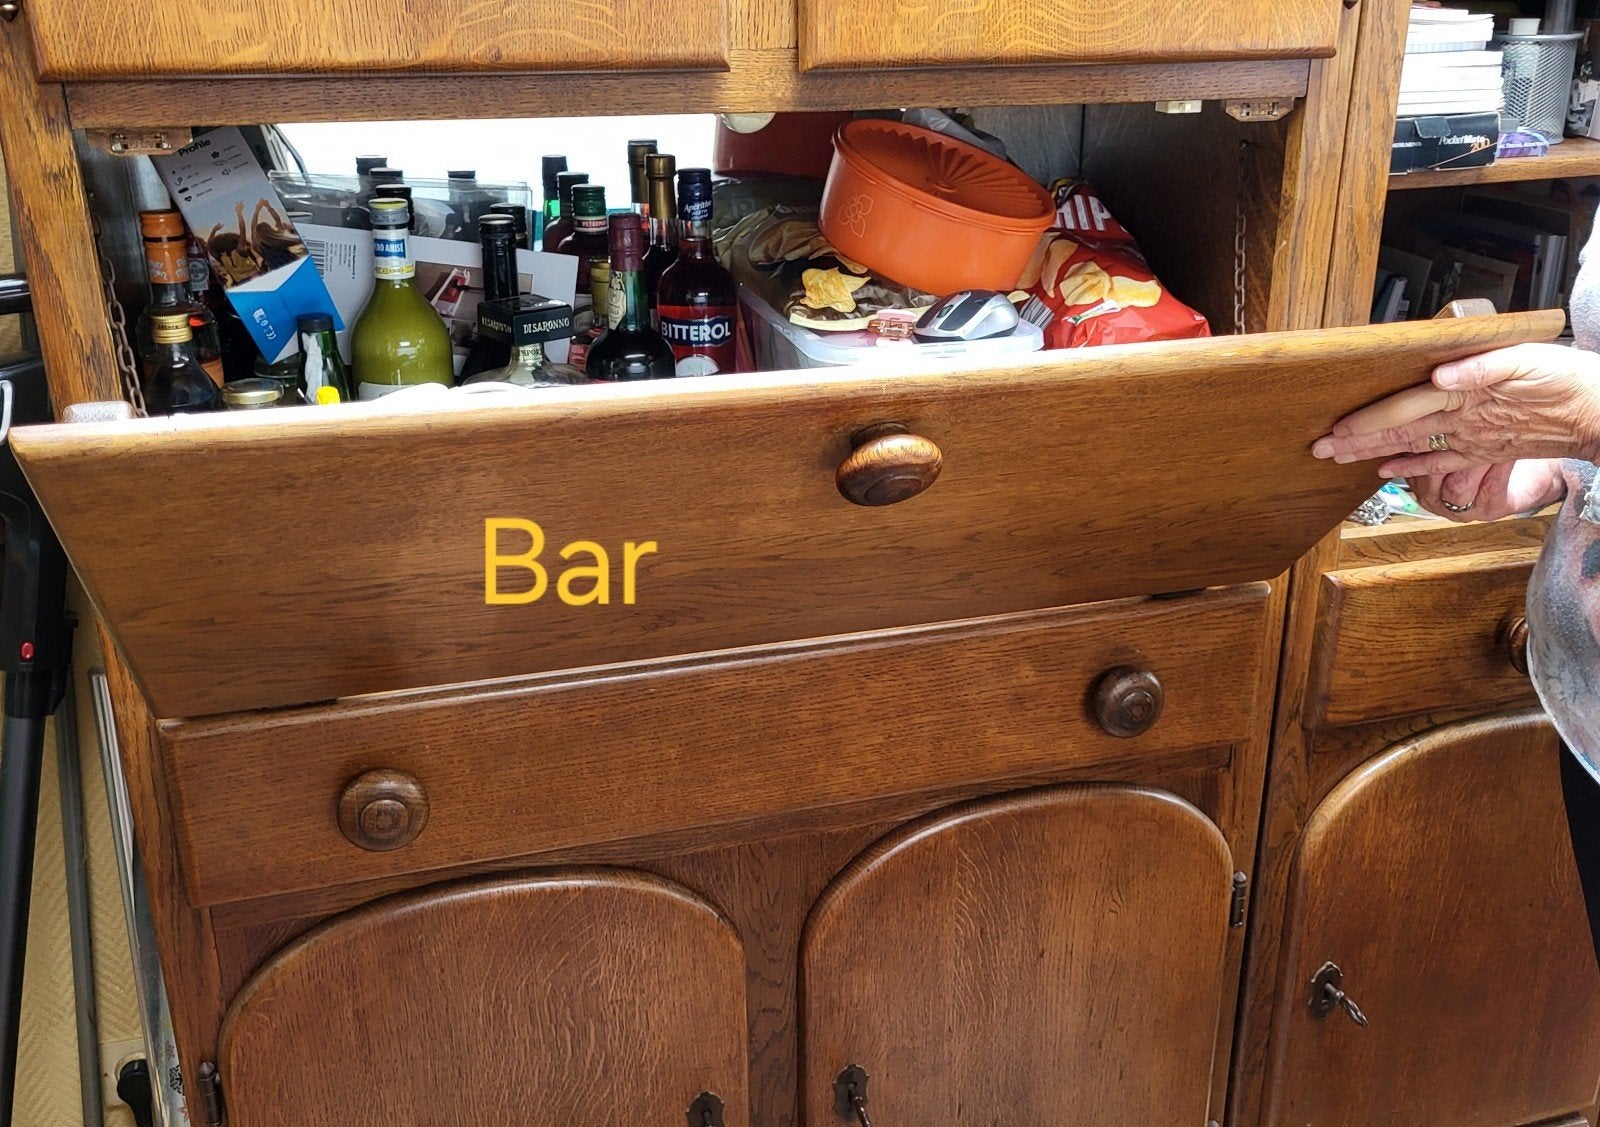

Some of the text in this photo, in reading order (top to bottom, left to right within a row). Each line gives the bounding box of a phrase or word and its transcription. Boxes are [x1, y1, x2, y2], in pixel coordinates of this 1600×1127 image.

[1470, 138, 1491, 153] 200
[523, 317, 569, 334] DISARONNO
[661, 320, 731, 342] BITTEROL
